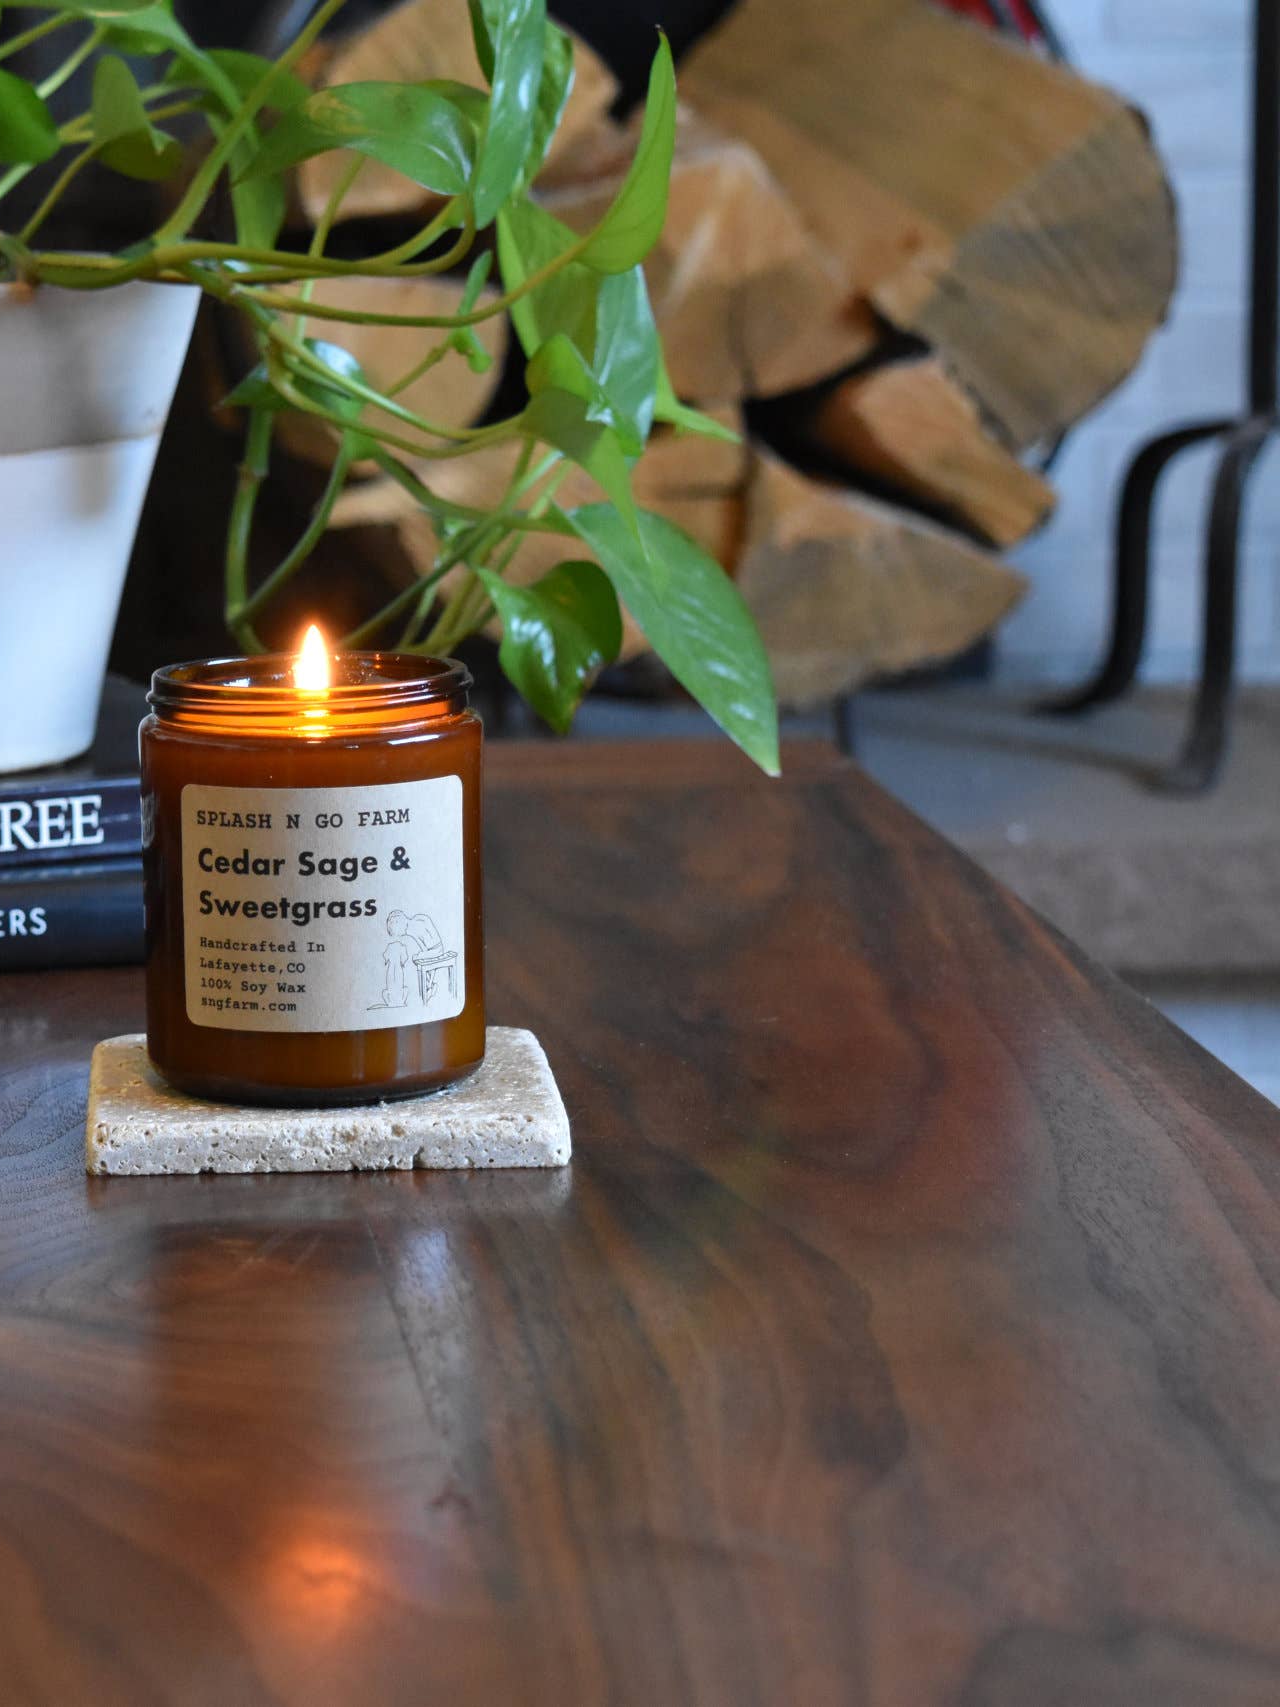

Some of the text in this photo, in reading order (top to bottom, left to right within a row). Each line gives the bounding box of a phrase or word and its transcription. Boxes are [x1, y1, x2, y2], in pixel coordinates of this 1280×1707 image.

[196, 808, 411, 830] SPLASH N GO FARM
[197, 845, 412, 882] Cedar Sage &
[198, 889, 378, 926] Sweetgrass
[199, 936, 326, 953] Handcrafted In
[200, 977, 306, 995] 100% Soy Wax
[200, 996, 297, 1012] sngfarm.com
